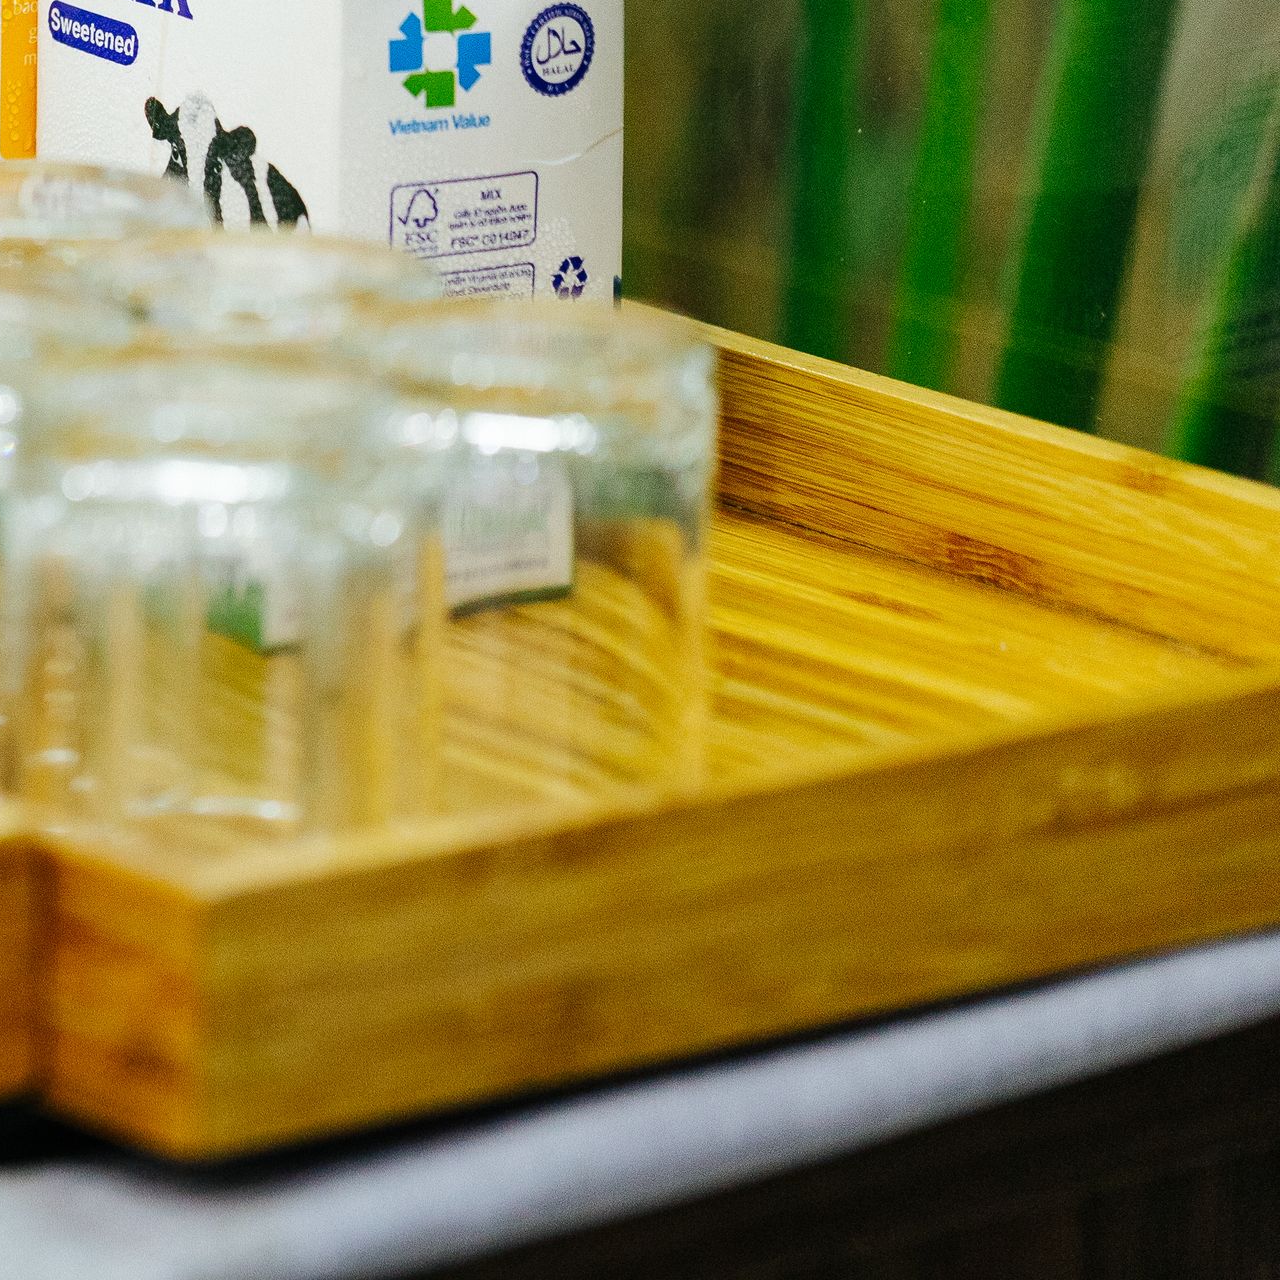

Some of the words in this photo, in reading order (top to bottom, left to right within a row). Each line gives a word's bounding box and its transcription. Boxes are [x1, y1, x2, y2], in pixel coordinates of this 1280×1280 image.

[50, 6, 136, 59] Sweetened
[390, 116, 449, 135] Vietnam
[452, 113, 490, 130] Value
